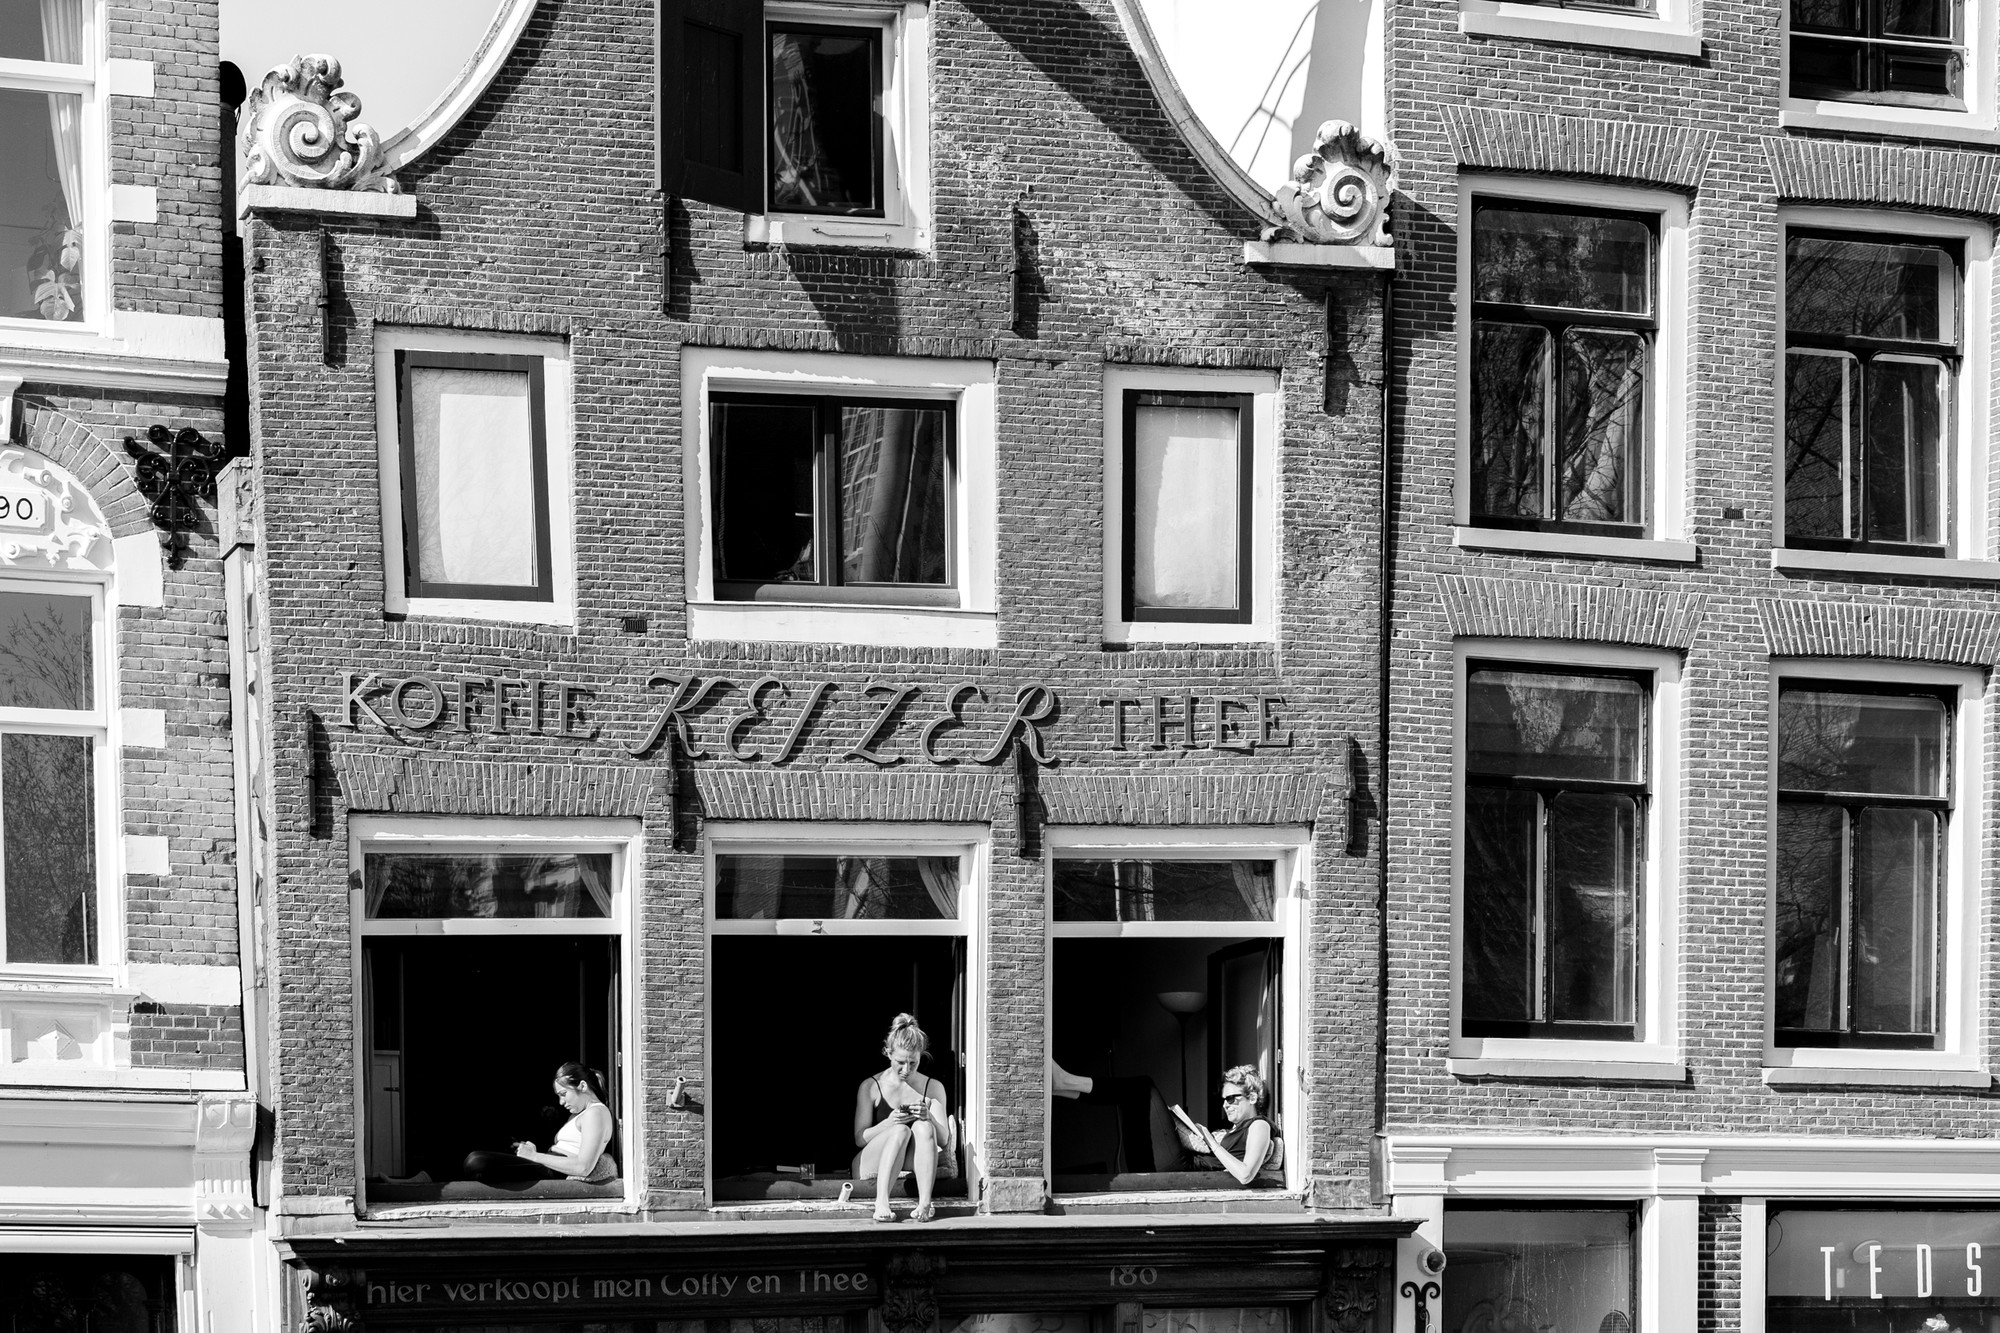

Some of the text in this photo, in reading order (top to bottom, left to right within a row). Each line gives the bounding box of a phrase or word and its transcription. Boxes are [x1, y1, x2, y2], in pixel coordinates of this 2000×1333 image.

[338, 671, 1292, 764] KOFFIE KEIZER THEE
[366, 1269, 868, 1304] hier verkoopt men Coffy en Thee
[1110, 1266, 1158, 1286] 180
[1820, 1242, 1982, 1301] TEDS
